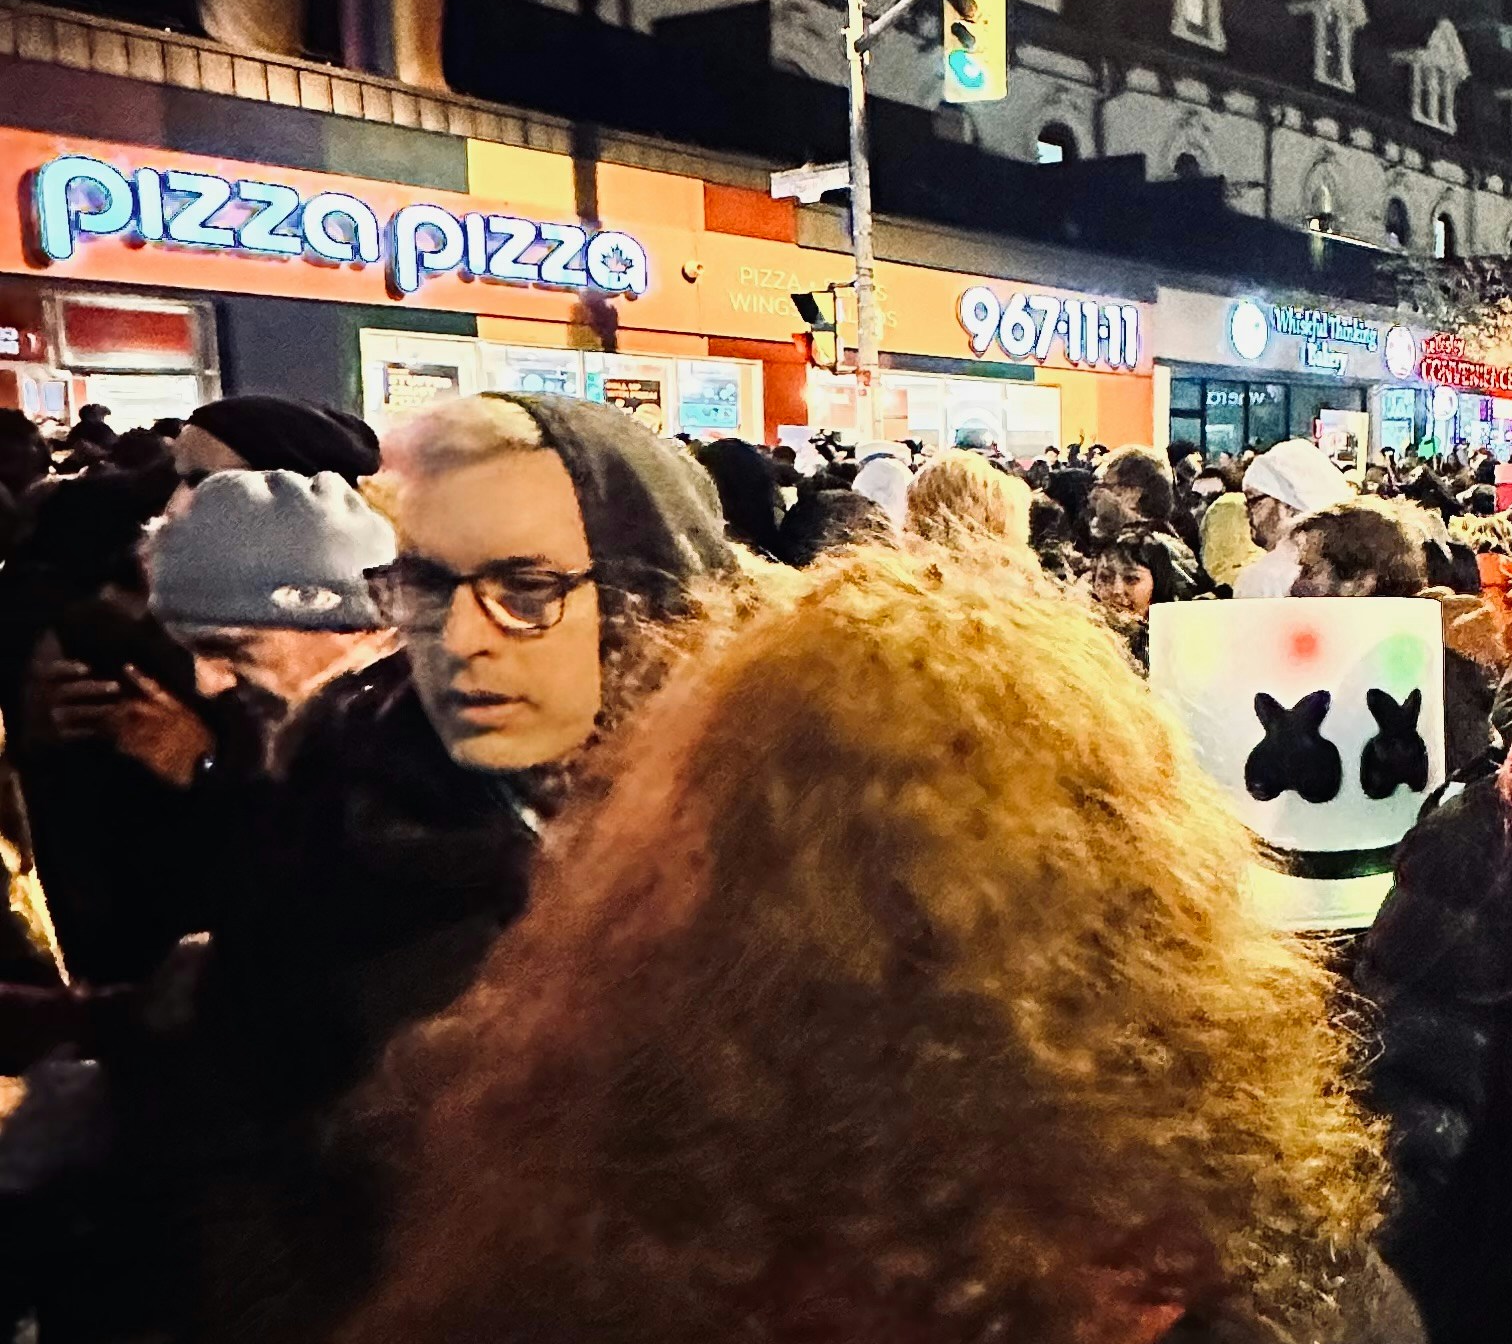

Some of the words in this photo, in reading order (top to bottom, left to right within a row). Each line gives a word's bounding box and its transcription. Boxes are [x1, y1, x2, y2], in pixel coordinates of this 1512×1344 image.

[38, 155, 379, 262] pizza
[394, 202, 648, 295] pizza
[739, 266, 800, 291] PIZZA
